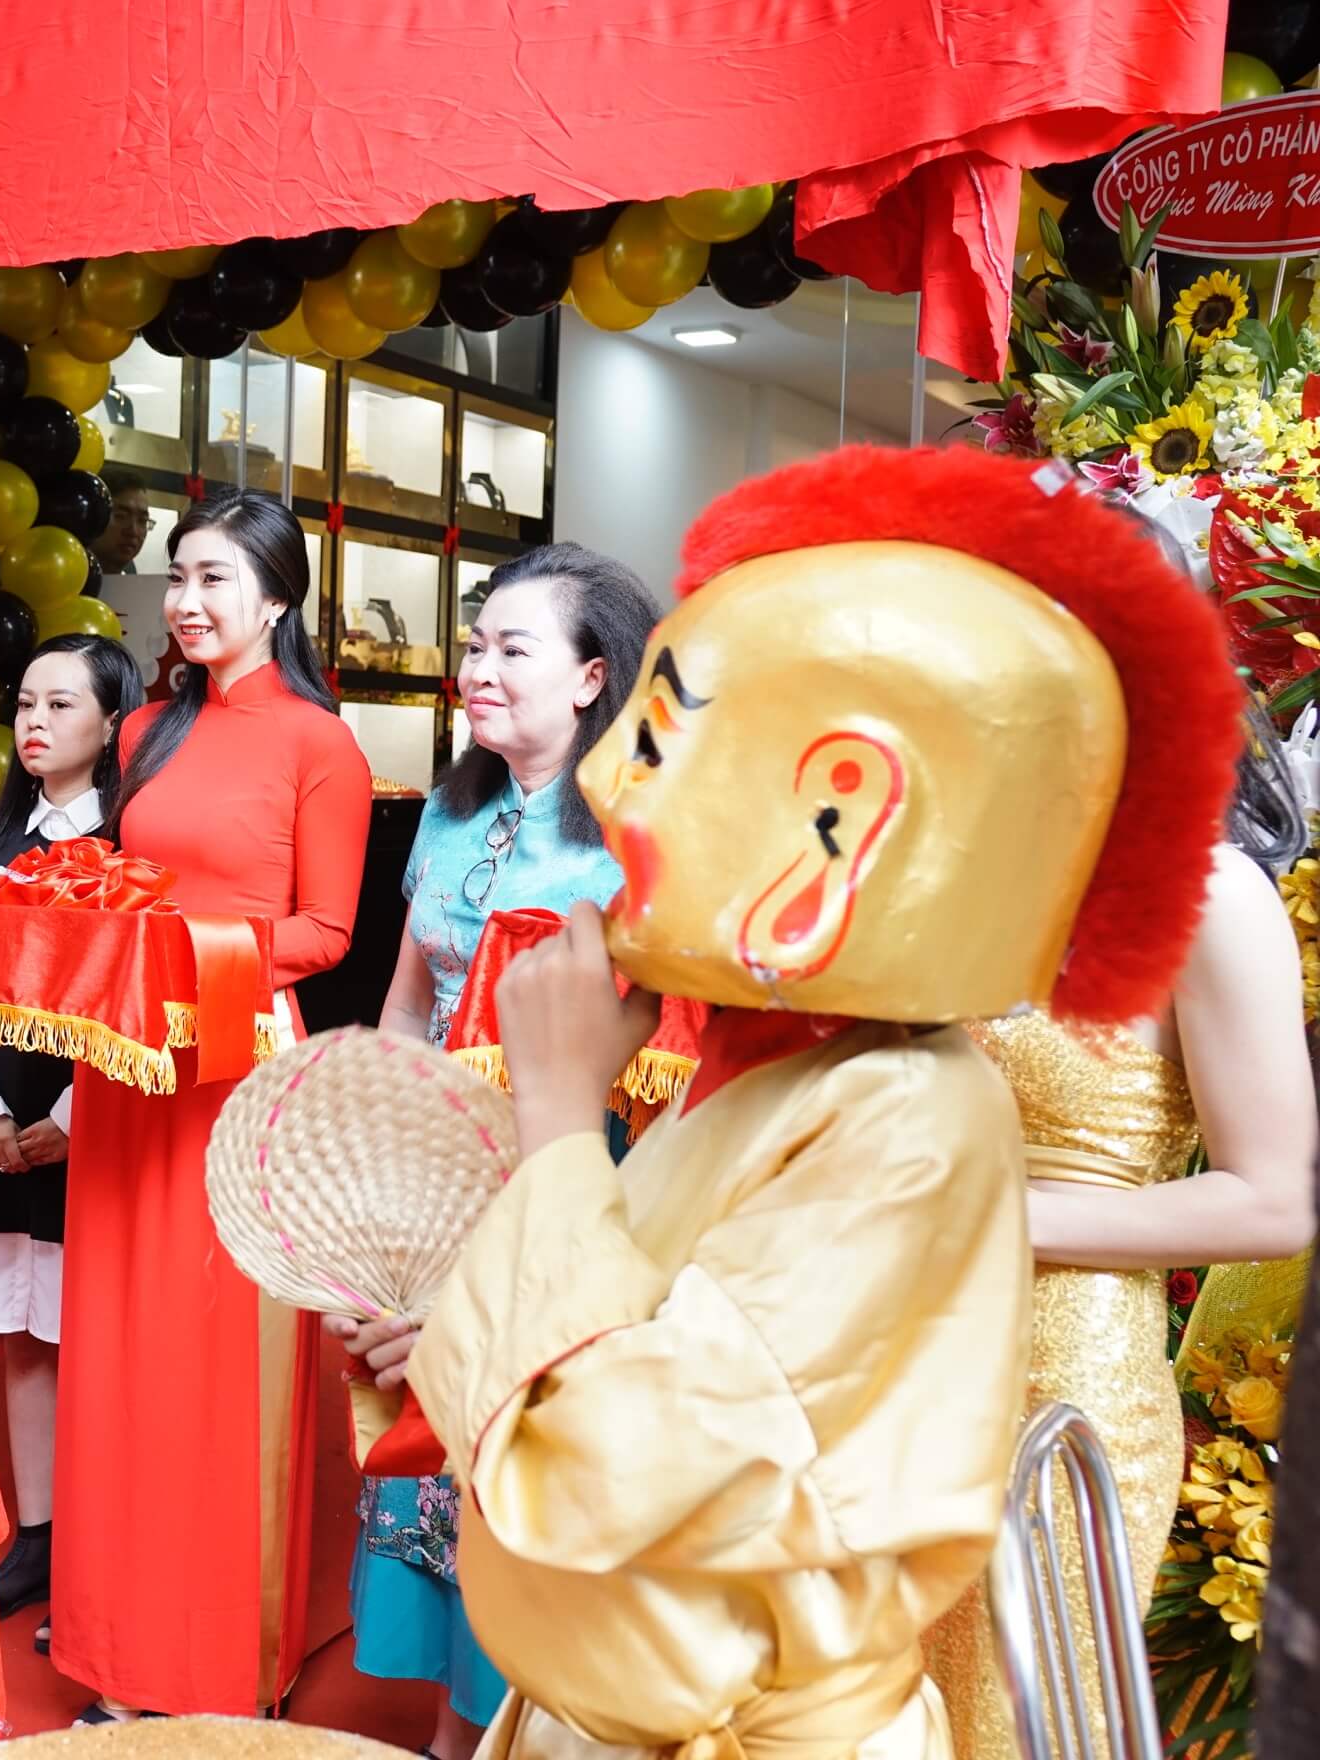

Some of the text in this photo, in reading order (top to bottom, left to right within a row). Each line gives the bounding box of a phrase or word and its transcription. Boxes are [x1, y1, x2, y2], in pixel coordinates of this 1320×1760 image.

[1116, 150, 1180, 200] CÔNG
[1187, 137, 1214, 175] TY
[1220, 121, 1253, 167] CỔ
[1140, 185, 1196, 224] Chúc
[1205, 180, 1274, 222] Mừng
